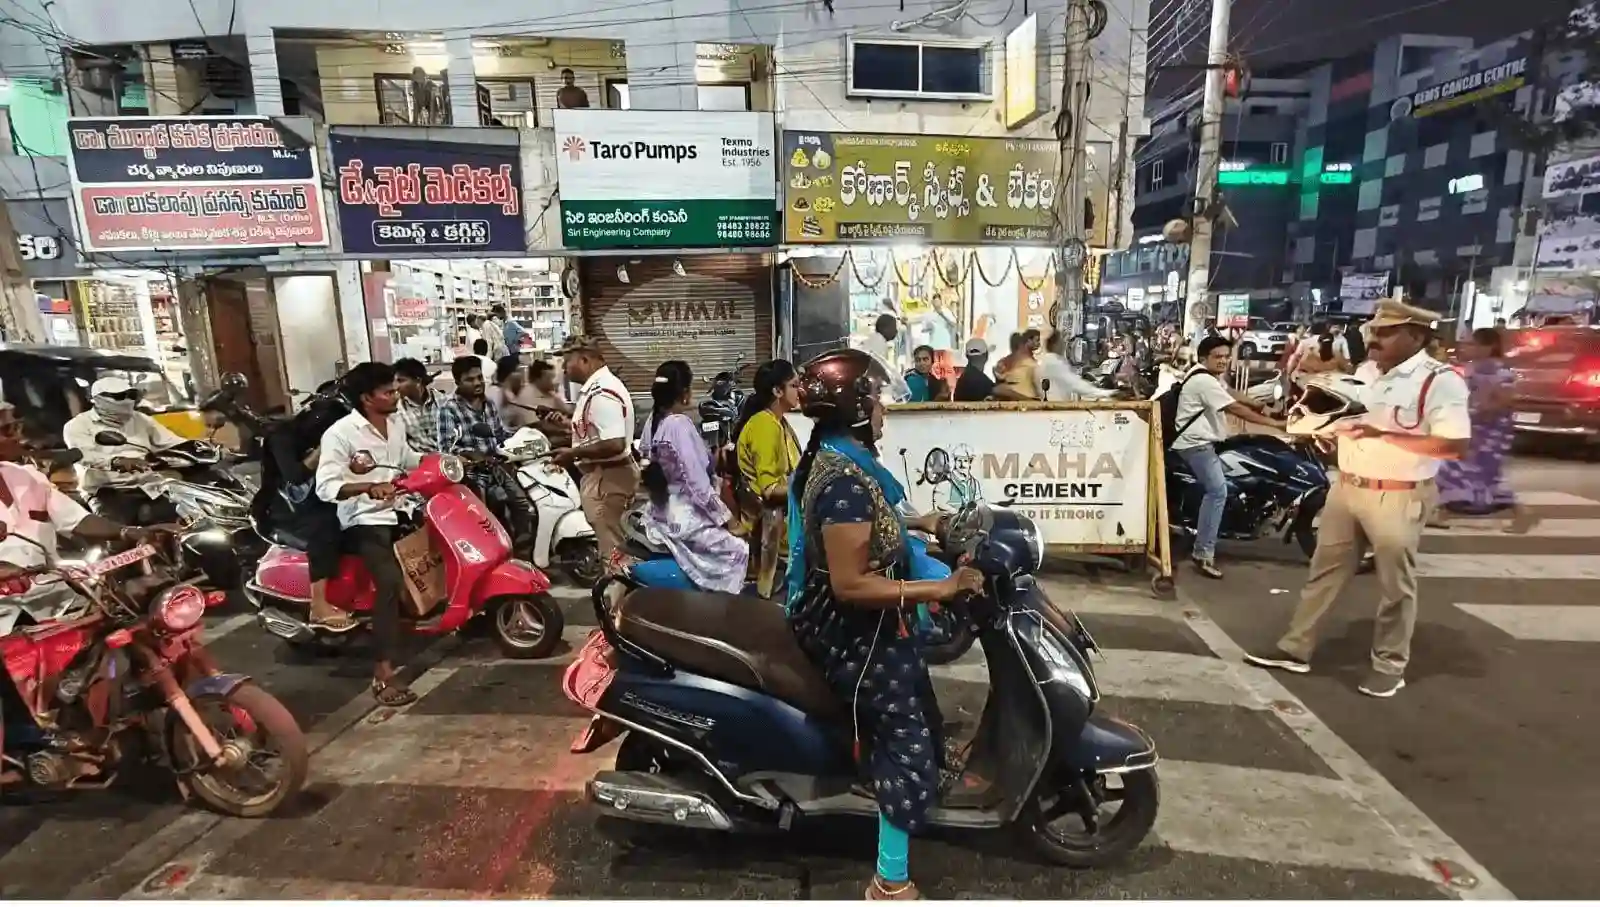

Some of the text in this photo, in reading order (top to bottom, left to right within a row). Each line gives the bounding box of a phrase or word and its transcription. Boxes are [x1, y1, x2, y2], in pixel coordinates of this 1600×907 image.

[171, 122, 212, 149] కనక
[720, 137, 753, 147] Texmo
[589, 140, 698, 163] Taro Pumps
[721, 147, 771, 157] Industries
[126, 162, 264, 180] చర్మ వ్యాధుల నిపుణులు
[721, 157, 762, 167] Est. 1956
[423, 163, 519, 216] మెడికల్స్
[975, 173, 999, 208] &
[199, 189, 250, 219] ప్రసన్న
[250, 185, 308, 212] కుమార్
[565, 209, 586, 225] సిరి
[379, 222, 426, 244] కెమిస్ట్
[430, 227, 440, 237] &
[567, 226, 671, 239] Siri Engineering Company
[657, 300, 742, 321] VIMAL
[982, 452, 1124, 479] MAHA
[1003, 482, 1103, 498] CEMENT
[1040, 509, 1051, 520] IT
[1054, 509, 1105, 520] STRONG
